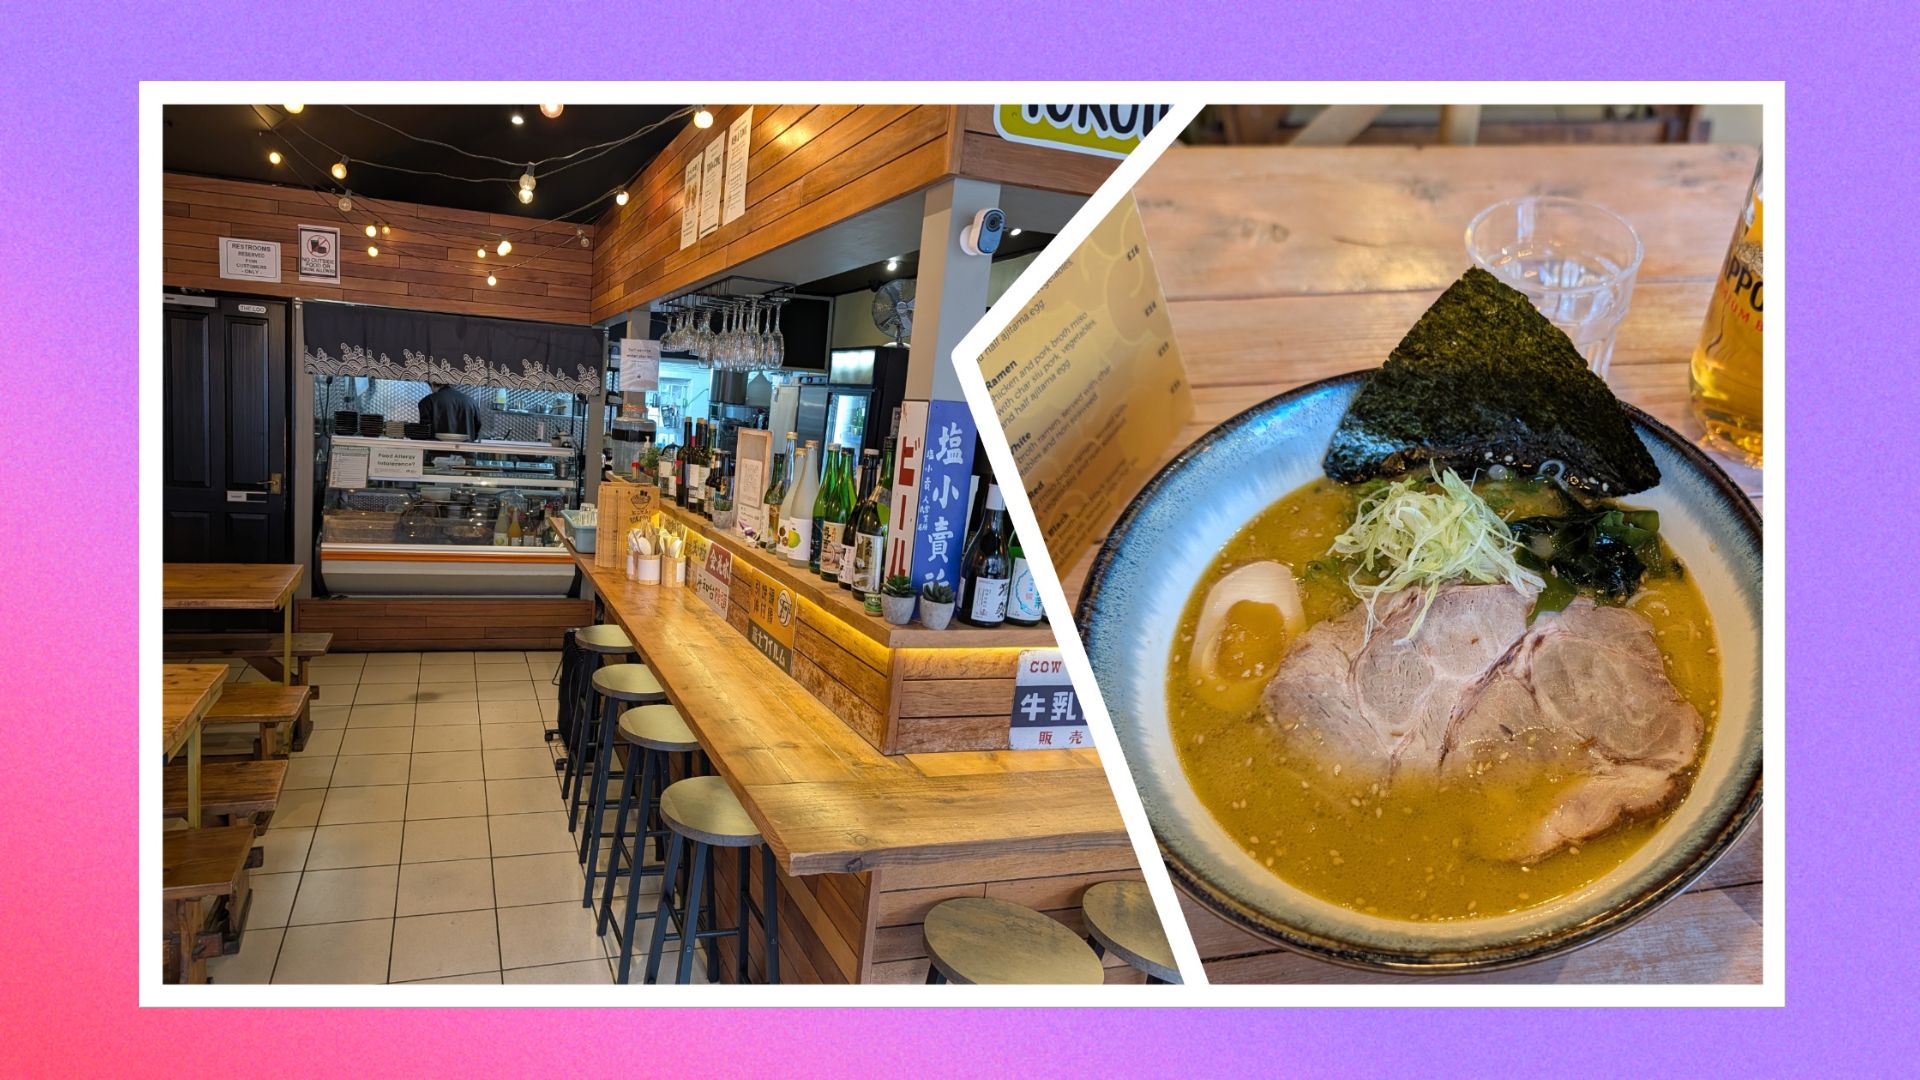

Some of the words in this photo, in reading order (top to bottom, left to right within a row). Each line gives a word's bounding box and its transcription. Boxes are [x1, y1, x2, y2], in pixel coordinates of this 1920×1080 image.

[231, 243, 271, 252] RESTROOMS
[1030, 299, 1045, 316] egg
[992, 377, 1019, 402] hicken
[1019, 361, 1035, 377] and
[1034, 345, 1052, 364] pork
[1051, 327, 1071, 348] broth
[1070, 312, 1088, 329] miso
[1015, 382, 1032, 400] char
[1061, 319, 1097, 354] vegetables
[986, 360, 1018, 391] Ramen
[1015, 397, 1030, 416] half
[1056, 359, 1071, 376] egg
[1029, 660, 1062, 673] COW
[1020, 691, 1085, 721] 牛乳
